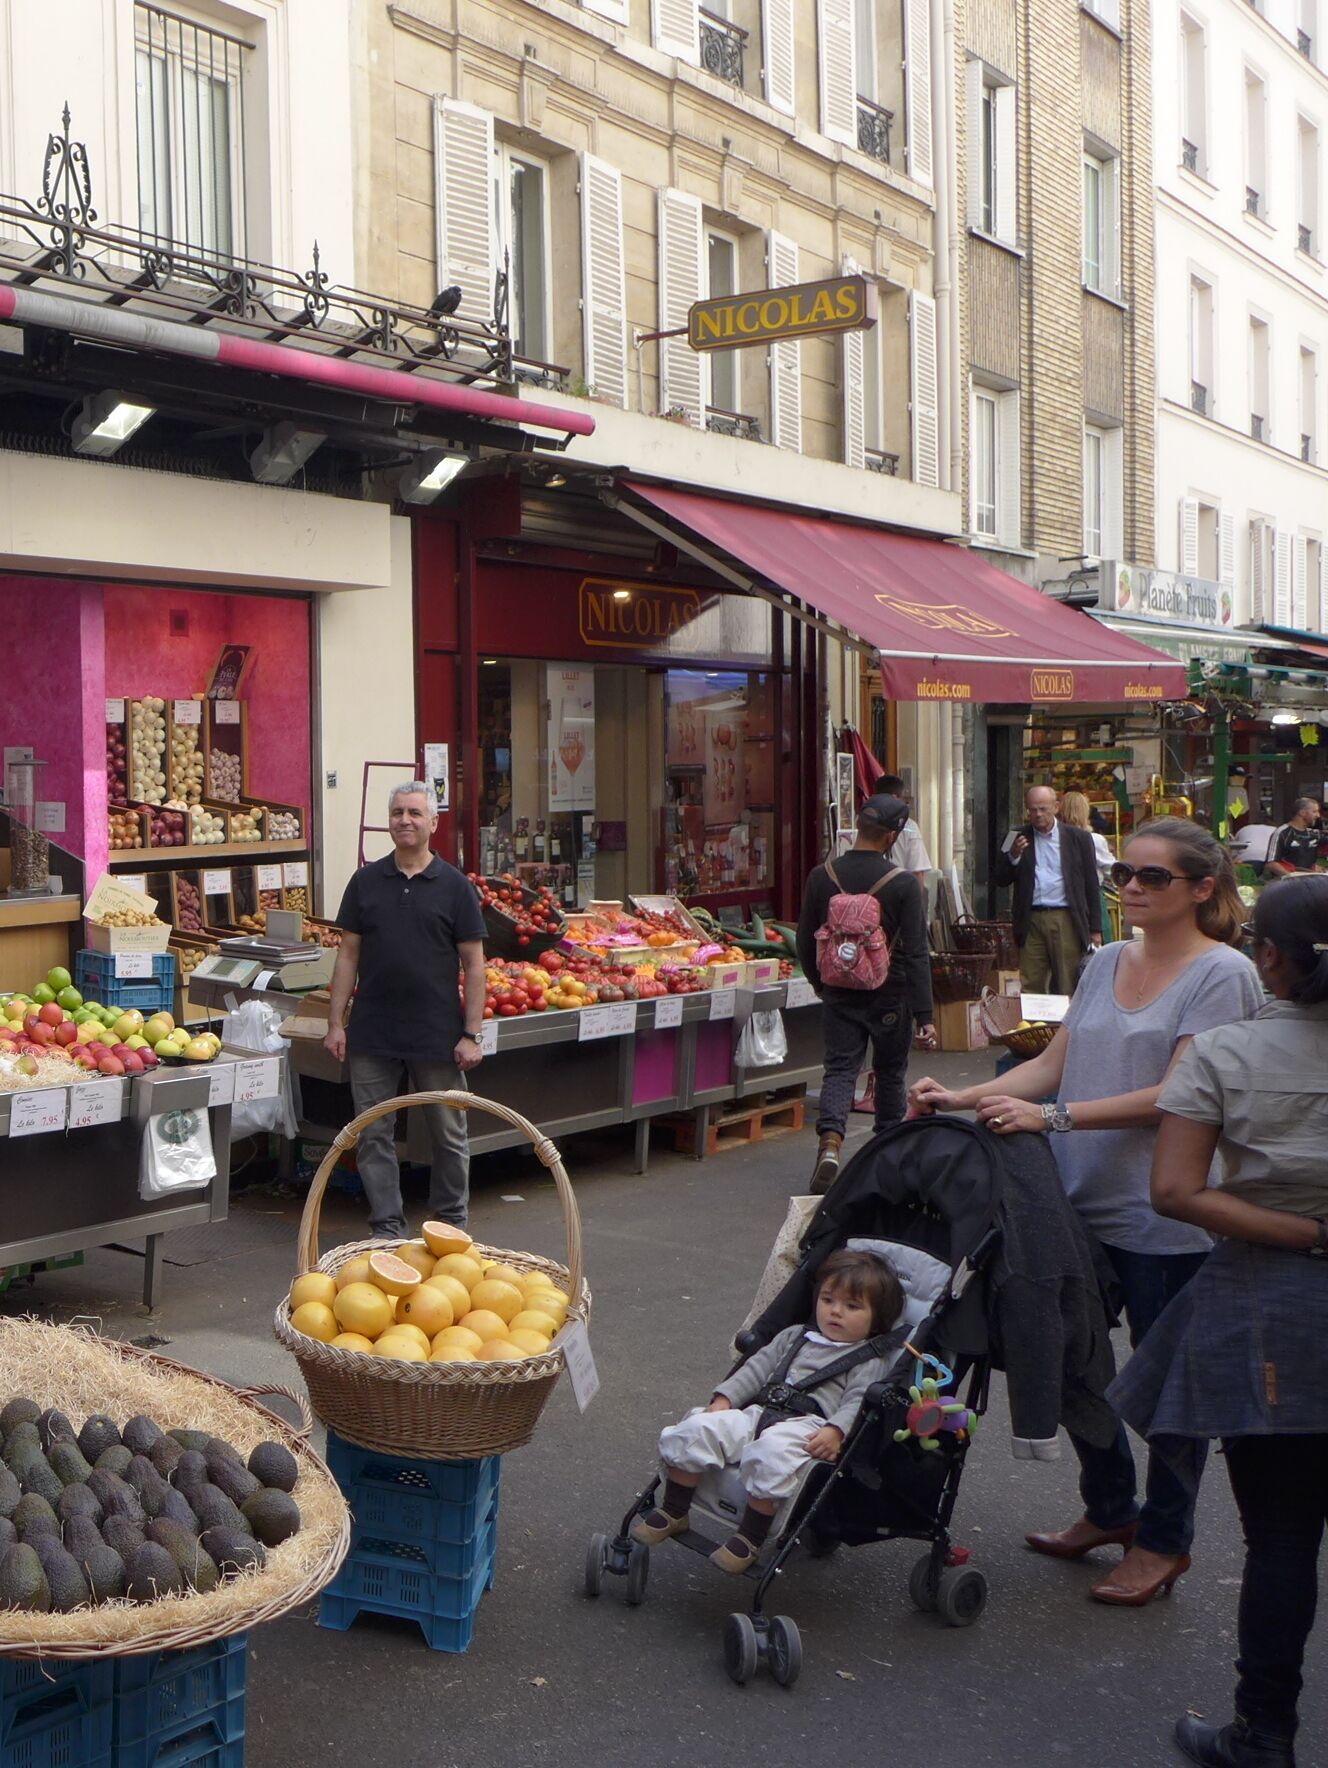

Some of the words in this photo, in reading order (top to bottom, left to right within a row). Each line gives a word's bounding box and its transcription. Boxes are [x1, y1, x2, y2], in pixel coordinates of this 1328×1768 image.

[696, 285, 858, 341] NICOLAS
[1139, 573, 1183, 613] Planète
[1185, 583, 1217, 620] Fruits
[917, 678, 971, 698] nicolas.com
[1033, 674, 1071, 696] NICOLAS
[1124, 682, 1163, 698] nicolas.com
[42, 1115, 58, 1127] 7.95
[75, 1115, 92, 1127] 4.95
